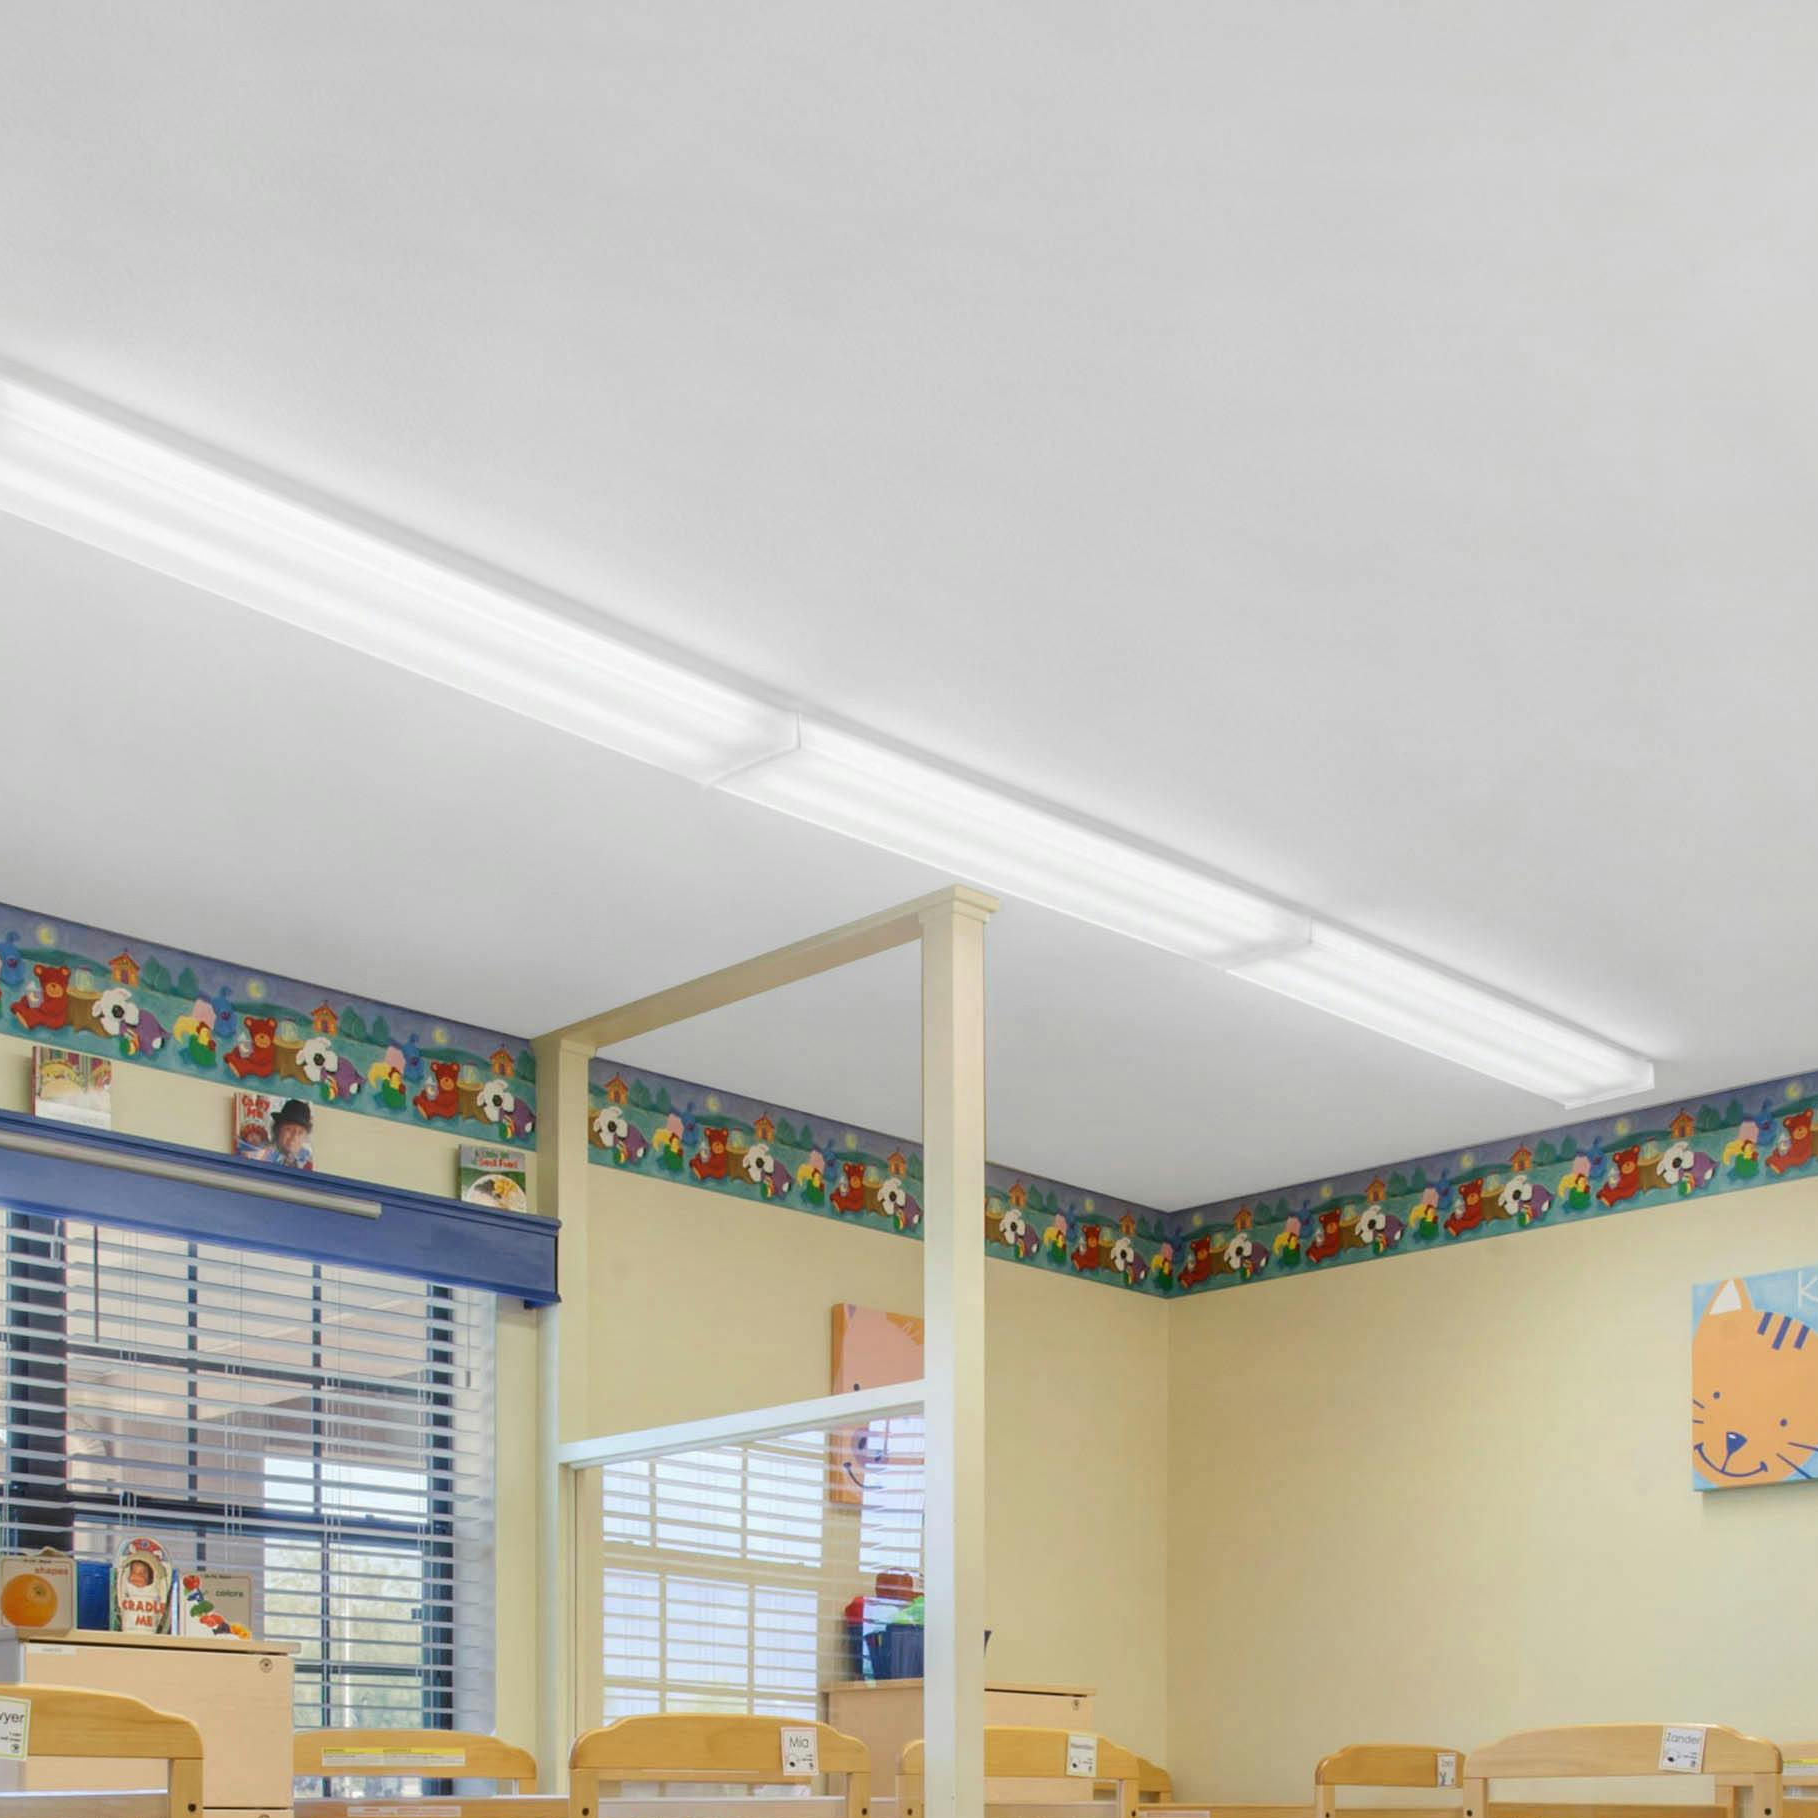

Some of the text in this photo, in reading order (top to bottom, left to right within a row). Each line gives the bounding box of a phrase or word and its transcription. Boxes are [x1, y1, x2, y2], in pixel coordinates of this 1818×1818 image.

[34, 1566, 70, 1578] shapes
[215, 1589, 245, 1599] colors
[121, 1600, 166, 1616] CRADLE
[135, 1615, 153, 1628] ME
[789, 1735, 810, 1749] Mia
